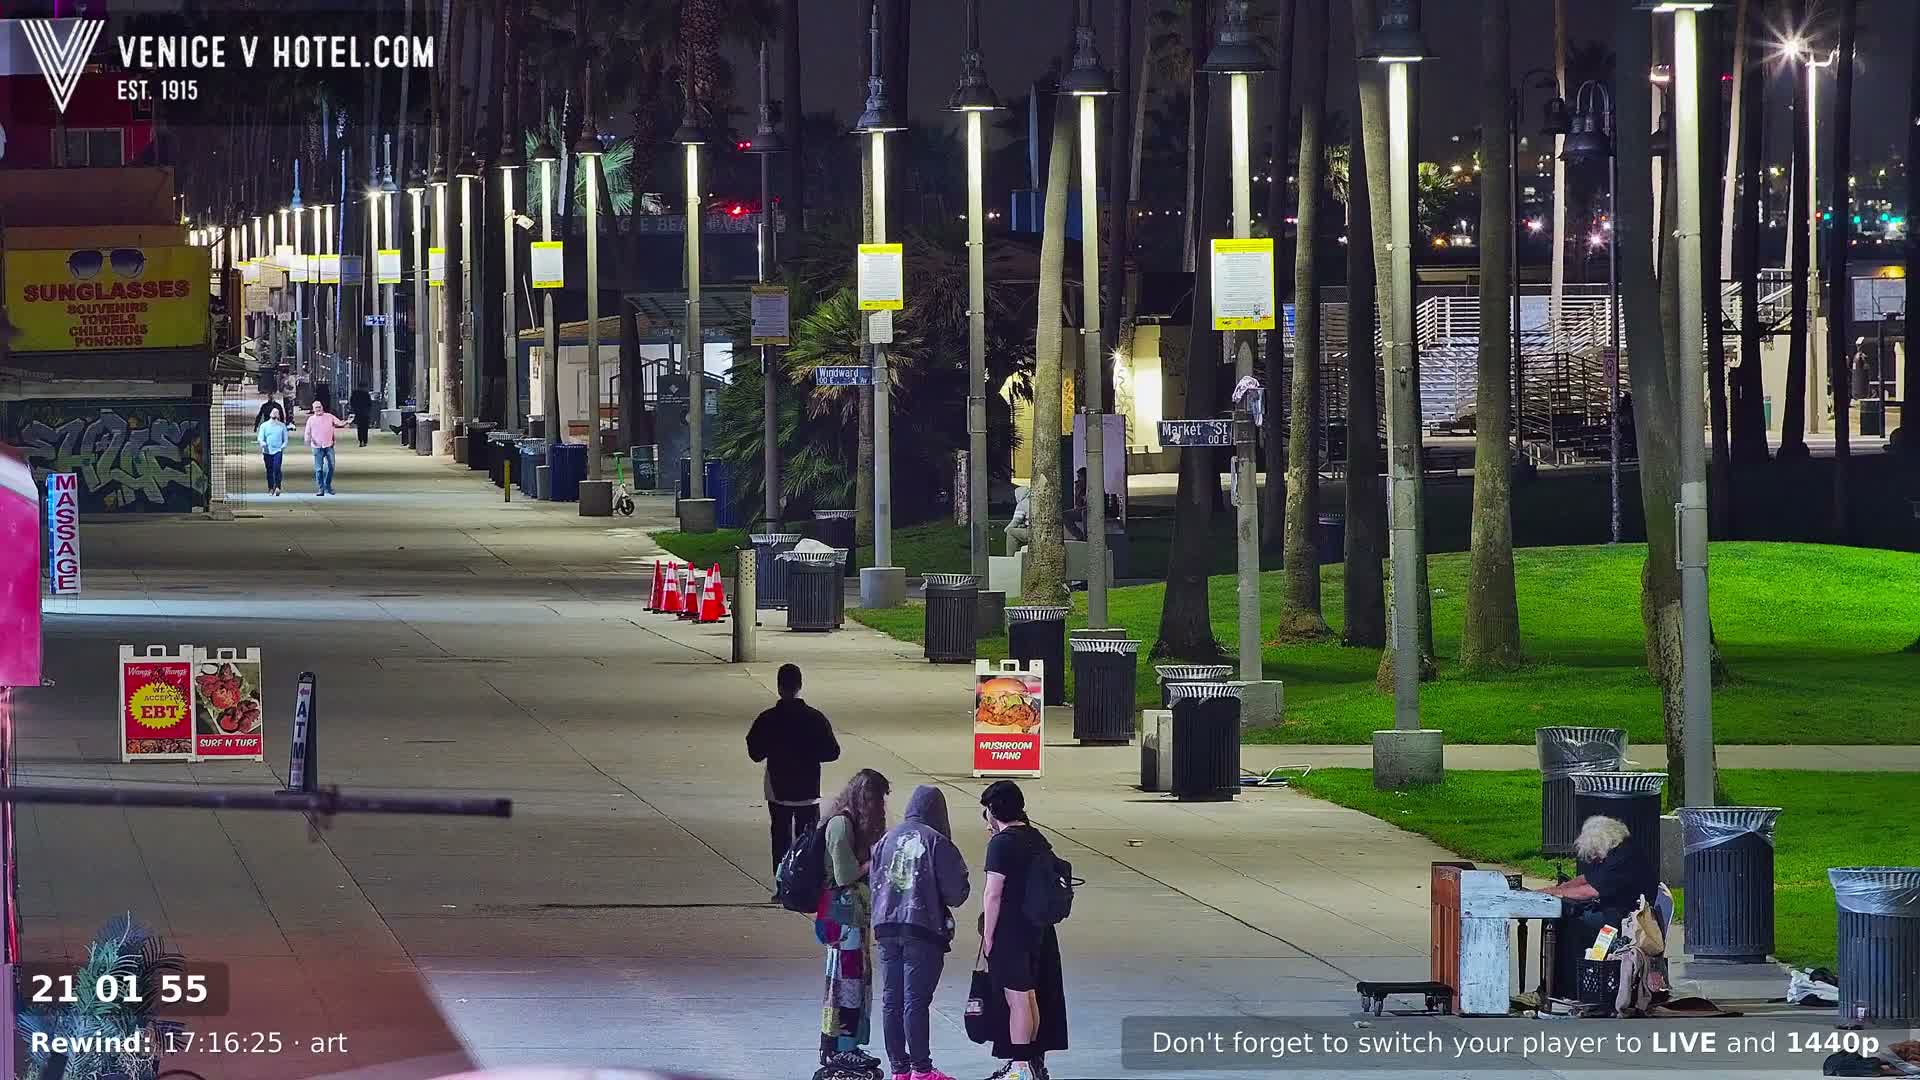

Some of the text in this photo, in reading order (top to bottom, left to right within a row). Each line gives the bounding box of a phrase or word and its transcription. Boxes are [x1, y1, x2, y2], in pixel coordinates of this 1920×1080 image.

[23, 280, 191, 303] SUNGLASSES
[67, 302, 148, 314] SOUVENIRS
[80, 314, 136, 325] TOWELS
[69, 324, 148, 336] CHILDRENS
[75, 335, 143, 347] PONCHOS
[819, 367, 858, 377] Windward
[1162, 422, 1228, 436] Market St
[1222, 435, 1228, 444] E
[56, 475, 78, 590] MASSAGE
[141, 705, 179, 719] EBT
[293, 701, 306, 759] ATM
[200, 739, 258, 748] SURF N TURF
[979, 741, 1032, 750] MUSHROOM
[991, 751, 1022, 760] THANG
